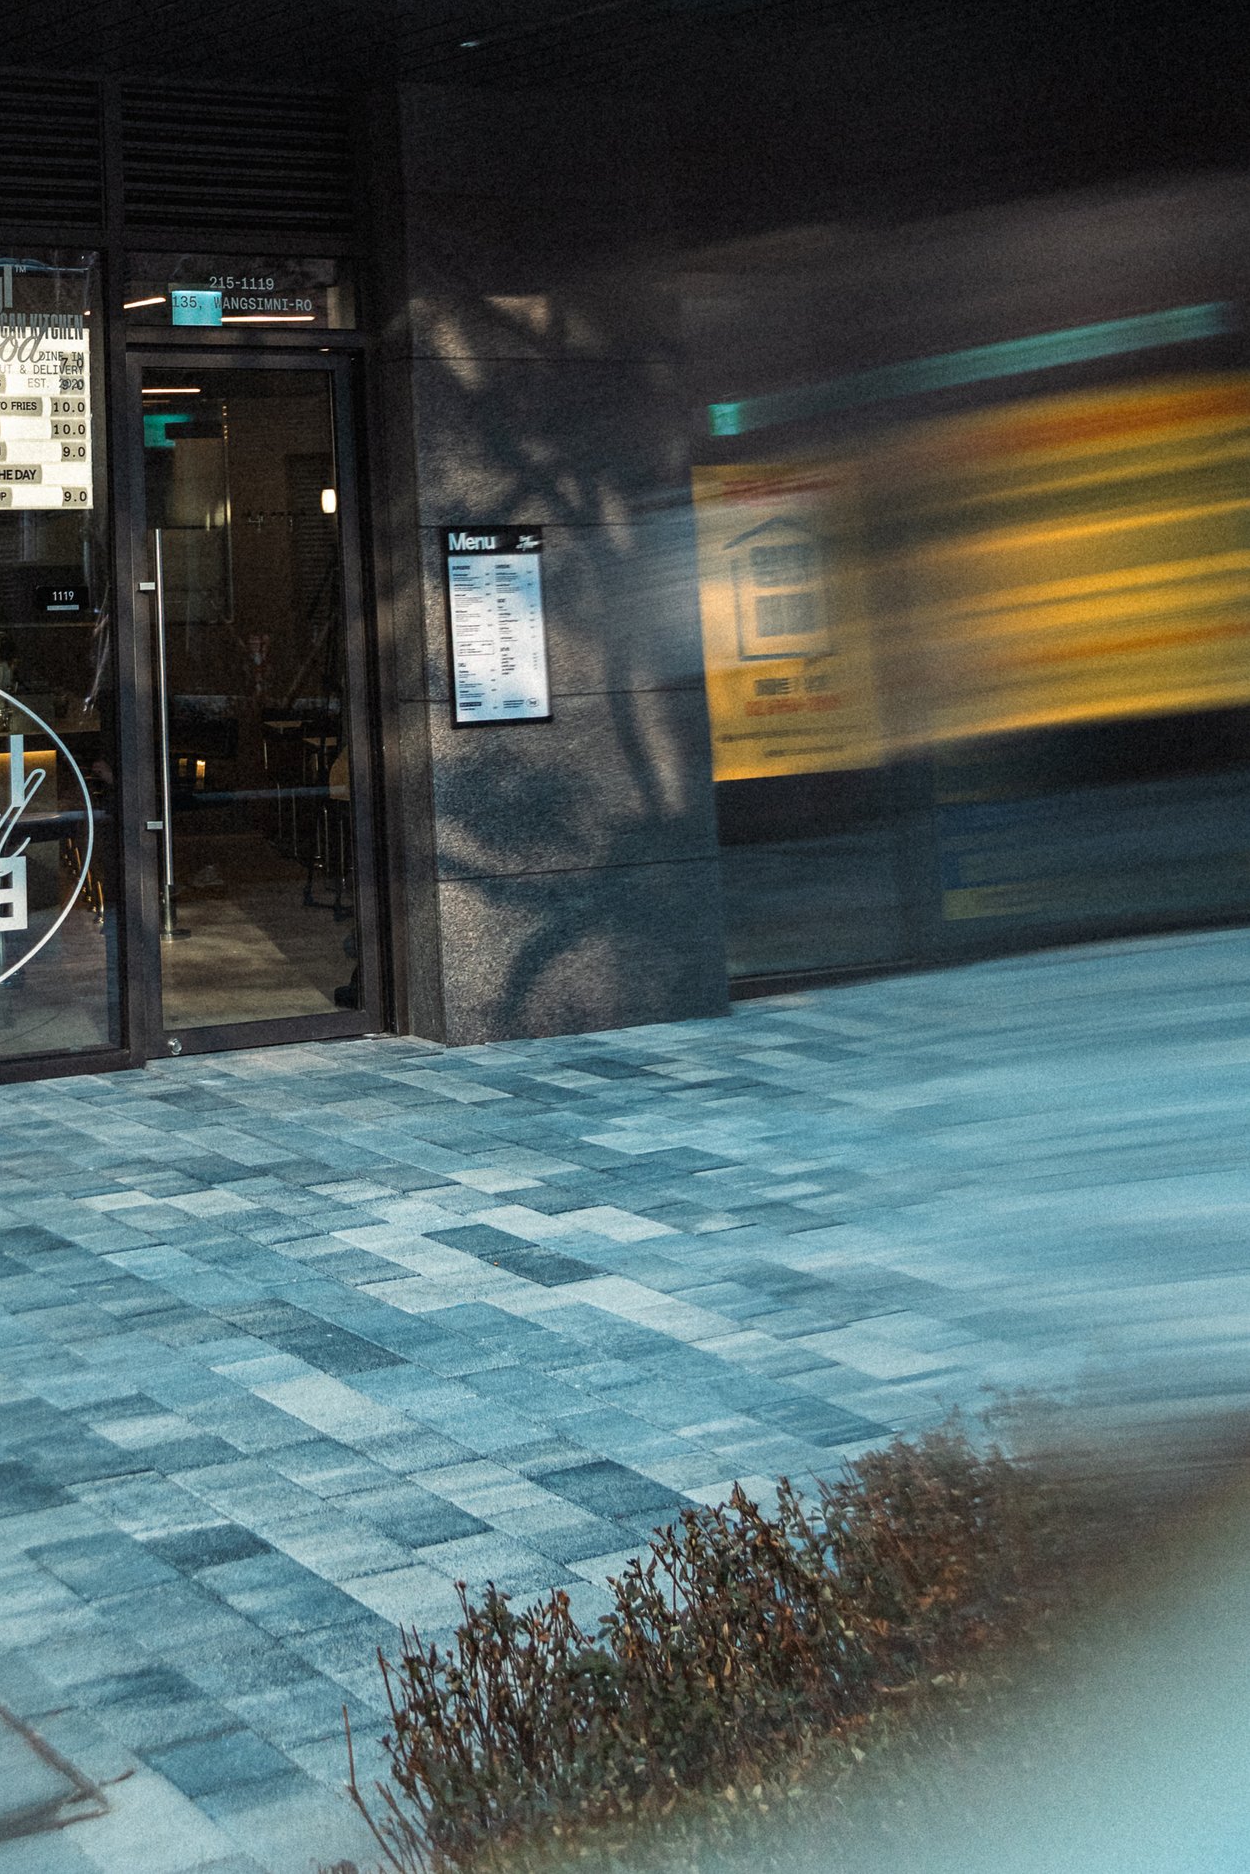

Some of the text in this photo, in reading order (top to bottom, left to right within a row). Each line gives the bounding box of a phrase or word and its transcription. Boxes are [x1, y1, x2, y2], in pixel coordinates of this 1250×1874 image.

[209, 276, 275, 291] 215-1119
[172, 295, 313, 312] 135, WANGSIMNI-RO
[39, 350, 63, 361] DINE
[33, 364, 84, 375] DELIVERY
[11, 401, 37, 411] FRIES
[53, 401, 85, 413] 10.0
[53, 424, 86, 435] 10.0
[63, 446, 86, 457] 9.0
[15, 470, 37, 480] DAY
[64, 491, 87, 502] 9.0
[448, 532, 497, 550] Menu
[52, 590, 74, 601] 1119
